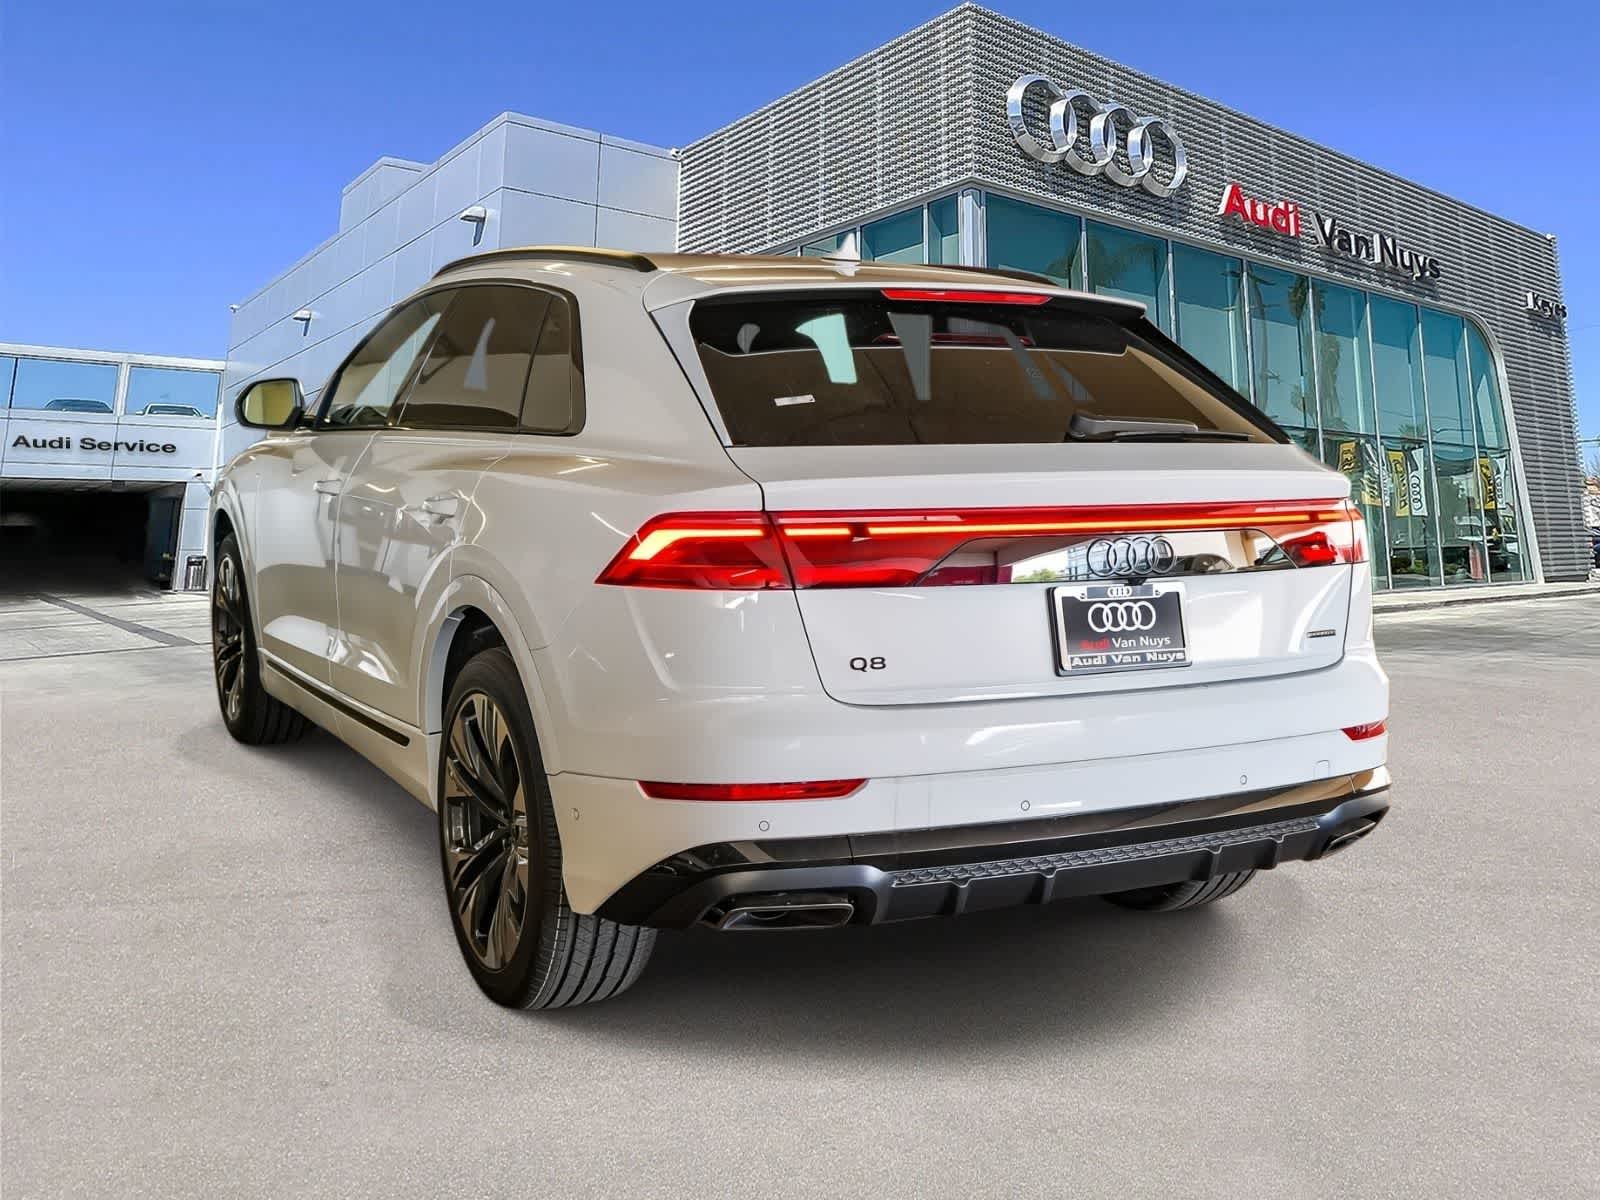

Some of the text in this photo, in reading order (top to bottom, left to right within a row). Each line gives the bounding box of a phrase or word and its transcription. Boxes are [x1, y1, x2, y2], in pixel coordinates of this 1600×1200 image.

[1217, 182, 1441, 280] Audi Van Nuys
[1526, 292, 1568, 319] Keyes
[12, 435, 177, 454] Audi Service
[1080, 635, 1171, 650] Audi Van Nuys
[849, 656, 887, 673] Q8
[1072, 652, 1185, 667] Audi Van Nuys
